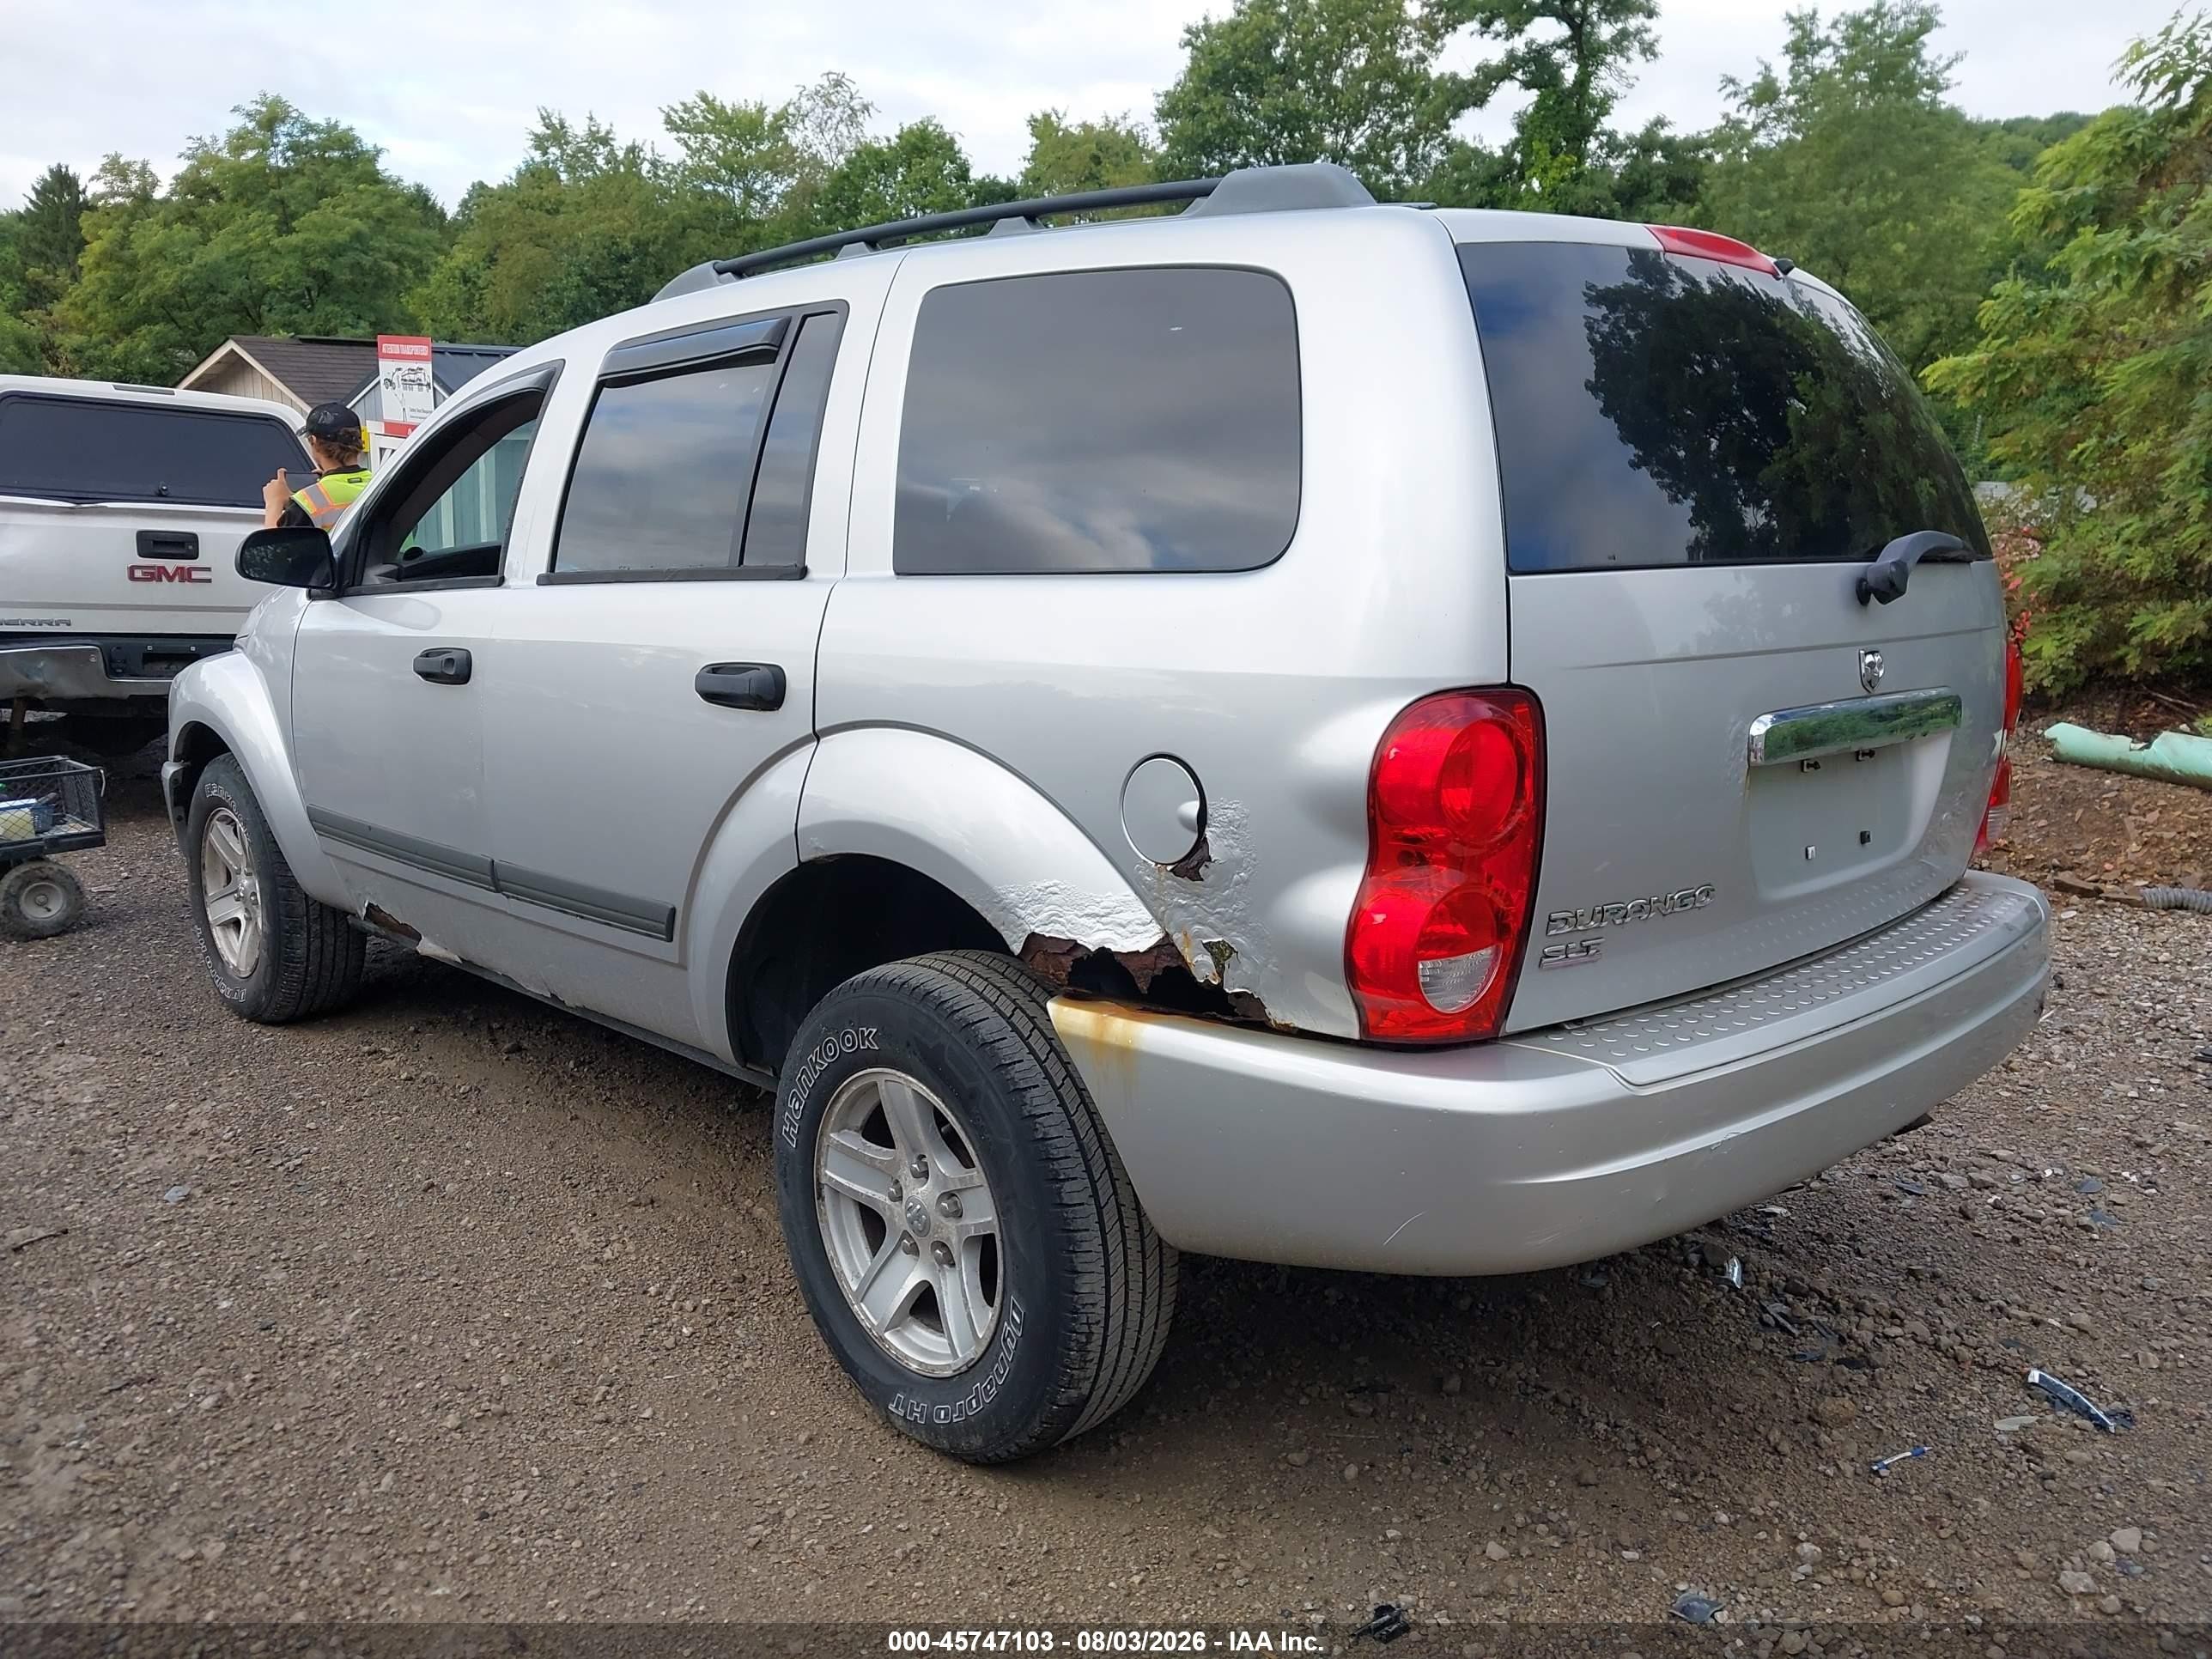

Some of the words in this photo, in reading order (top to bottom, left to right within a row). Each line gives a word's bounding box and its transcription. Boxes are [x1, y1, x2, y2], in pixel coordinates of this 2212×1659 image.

[127, 564, 213, 584] GMC
[1545, 884, 1716, 936] DURANGO
[933, 1295, 1024, 1424] Dynapro
[888, 1393, 928, 1425] HT
